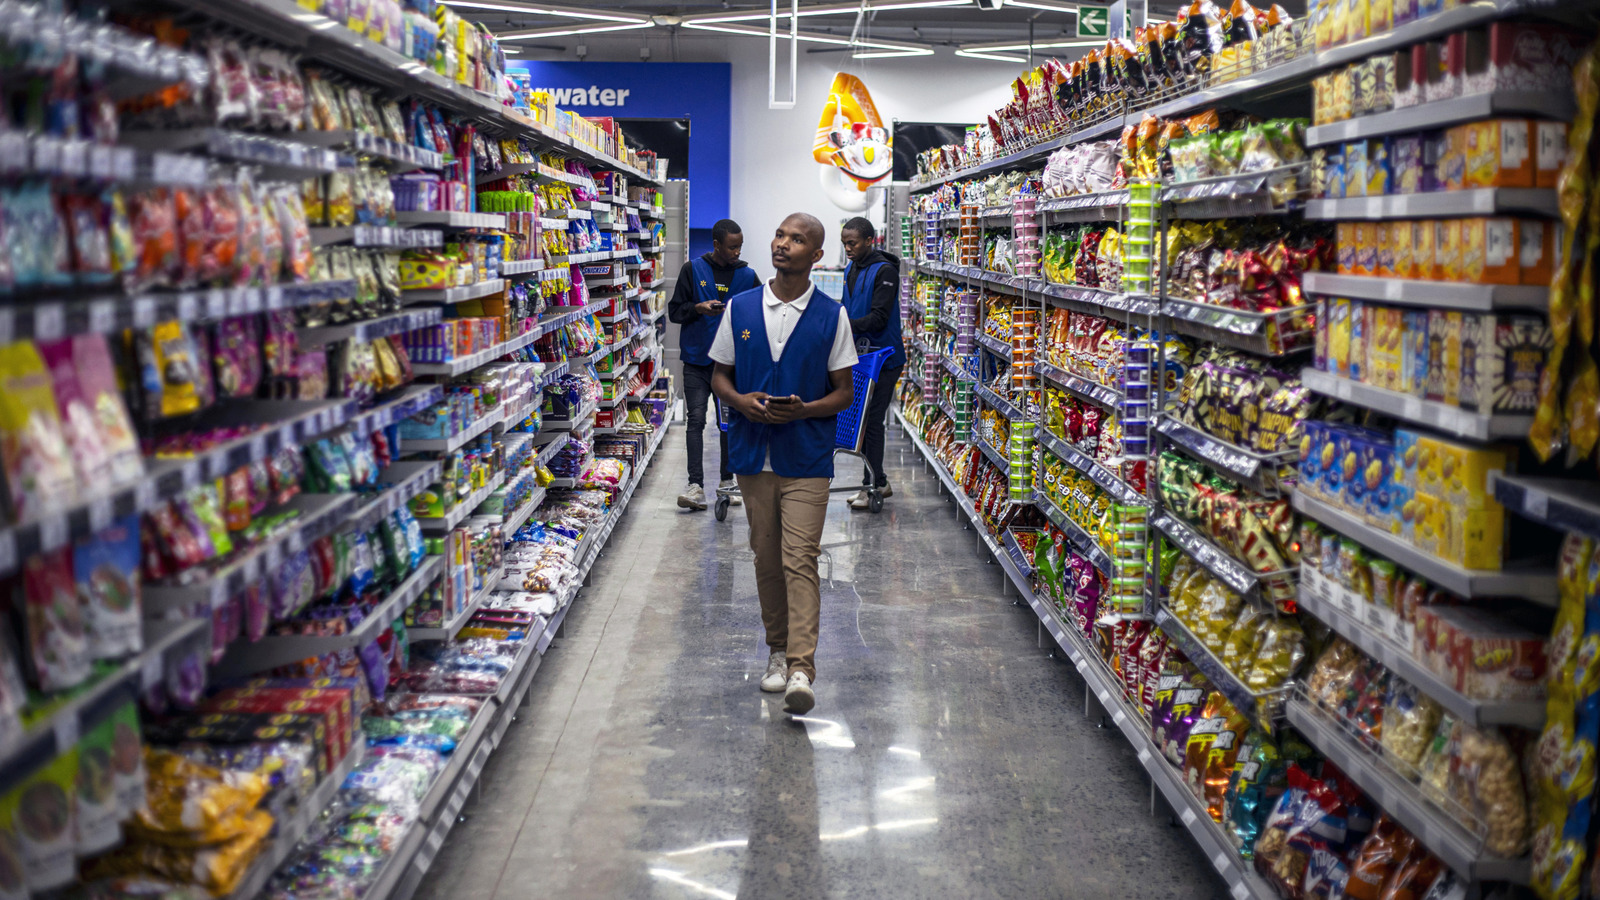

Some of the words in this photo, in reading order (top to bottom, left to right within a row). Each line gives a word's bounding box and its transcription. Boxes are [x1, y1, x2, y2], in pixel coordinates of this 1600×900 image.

[531, 85, 630, 106] water
[582, 266, 609, 275] SNICKERS
[1144, 670, 1159, 702] PARTY
